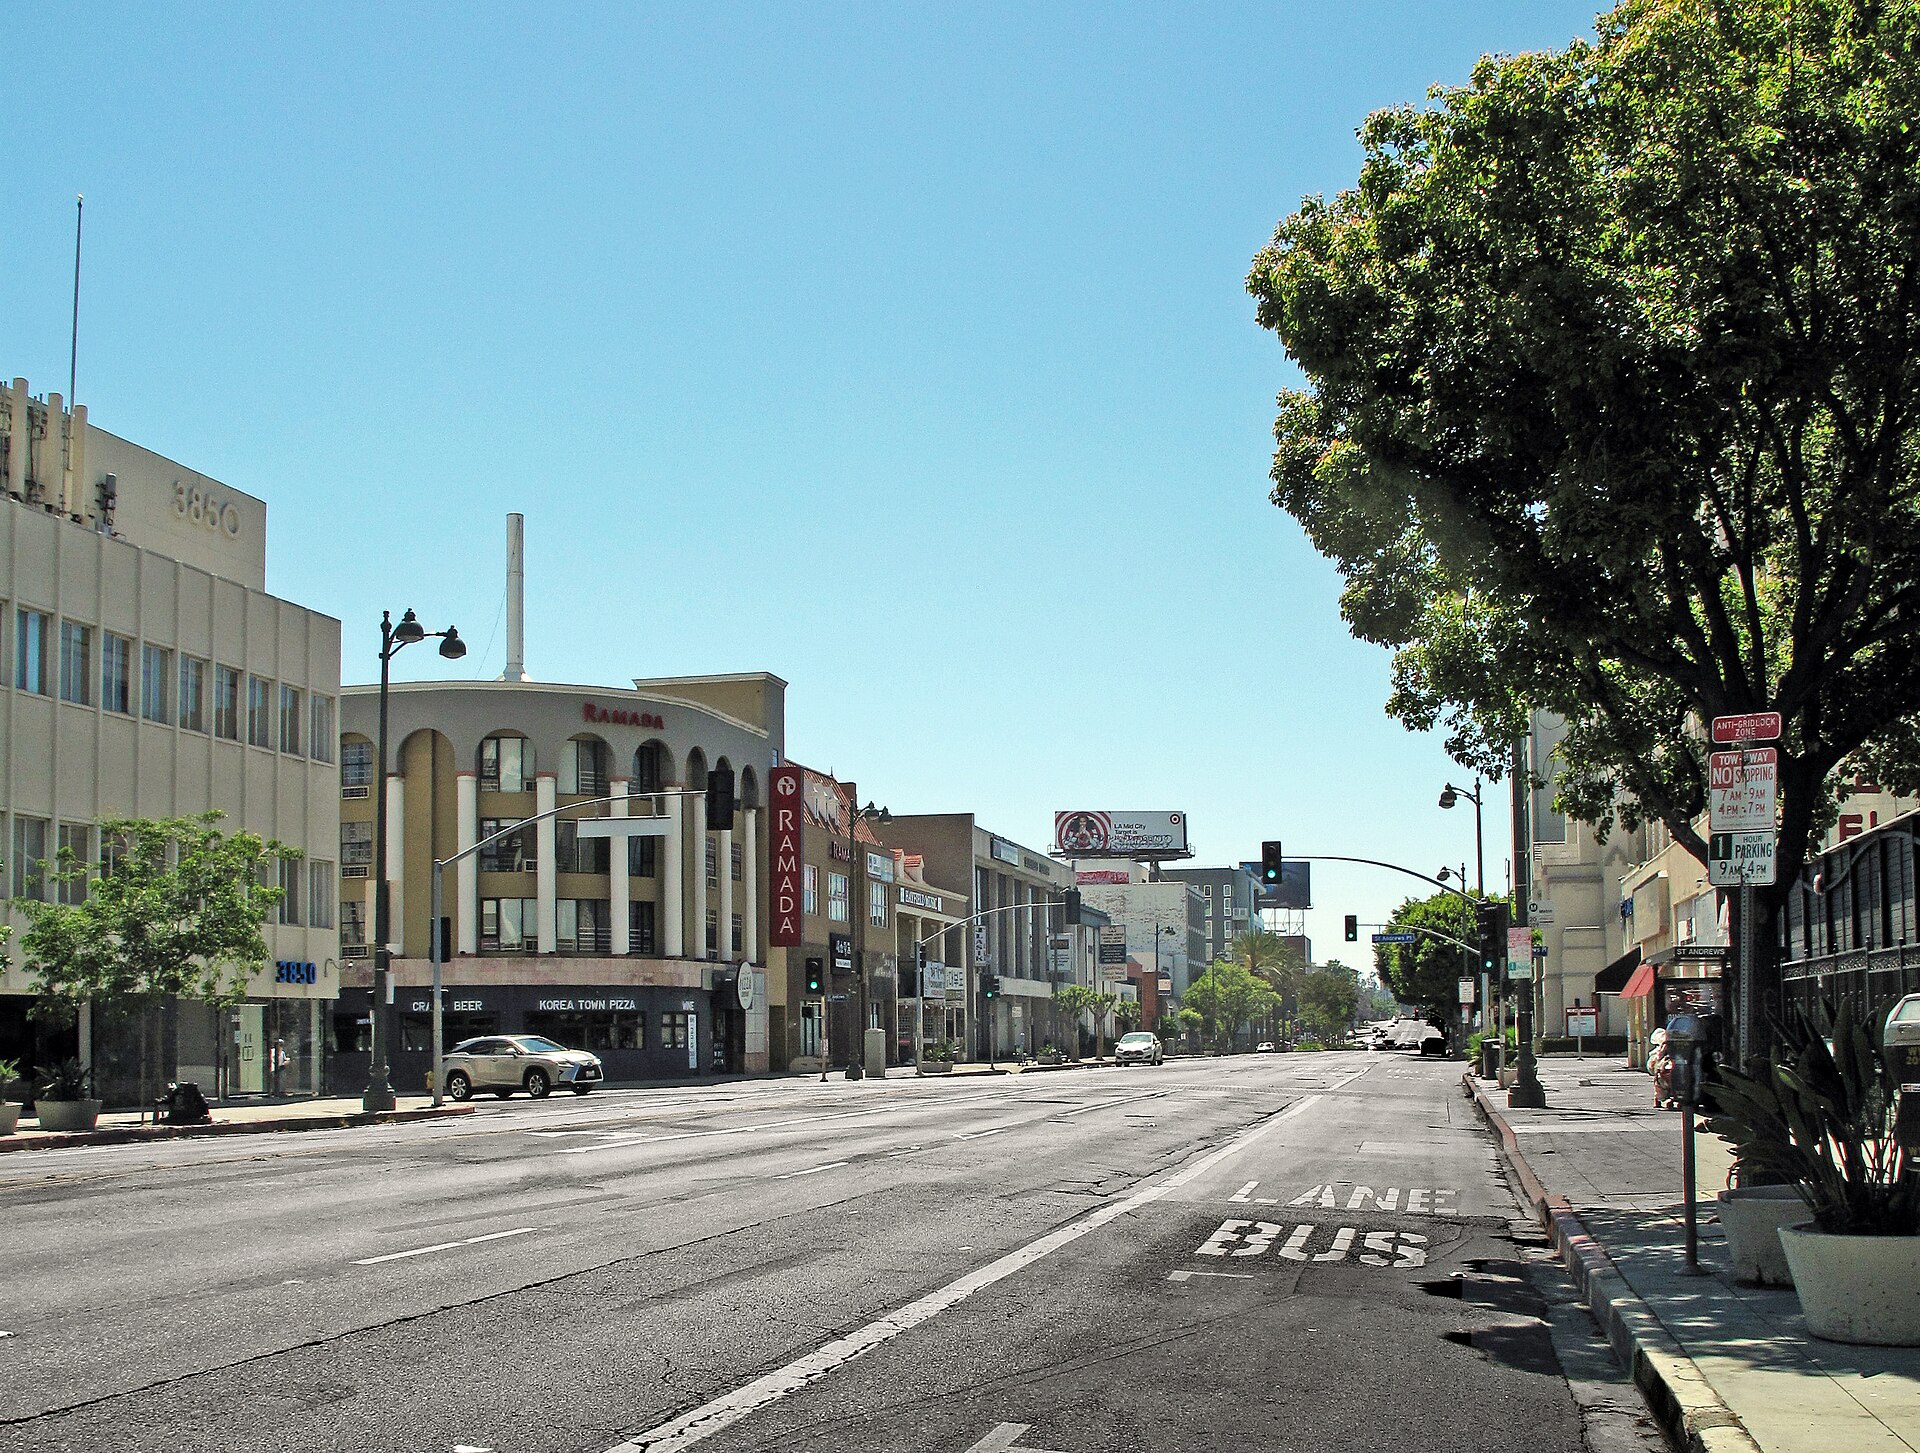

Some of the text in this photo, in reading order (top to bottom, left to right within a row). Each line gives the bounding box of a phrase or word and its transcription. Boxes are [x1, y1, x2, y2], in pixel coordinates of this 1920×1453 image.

[173, 481, 241, 540] 3850
[583, 703, 665, 730] RAMADA
[1716, 717, 1776, 730] ANTI-GRIDLOCK
[1735, 727, 1756, 737] ZONE
[1712, 766, 1733, 785] NO
[1721, 790, 1727, 801] 7
[1730, 791, 1741, 800] AM
[1719, 803, 1724, 815] 4
[1726, 804, 1738, 815] PM
[1717, 836, 1723, 858] 1
[1735, 843, 1772, 859] PARKING
[777, 809, 797, 934] RAMADA
[1720, 861, 1727, 875] 9
[1756, 864, 1766, 874] PM
[275, 960, 317, 985] 3850
[454, 1000, 482, 1011] BEER
[539, 999, 636, 1010] KOREA TOWN PIZZA
[1226, 1181, 1458, 1214] LANE
[1193, 1218, 1429, 1268] BUS
